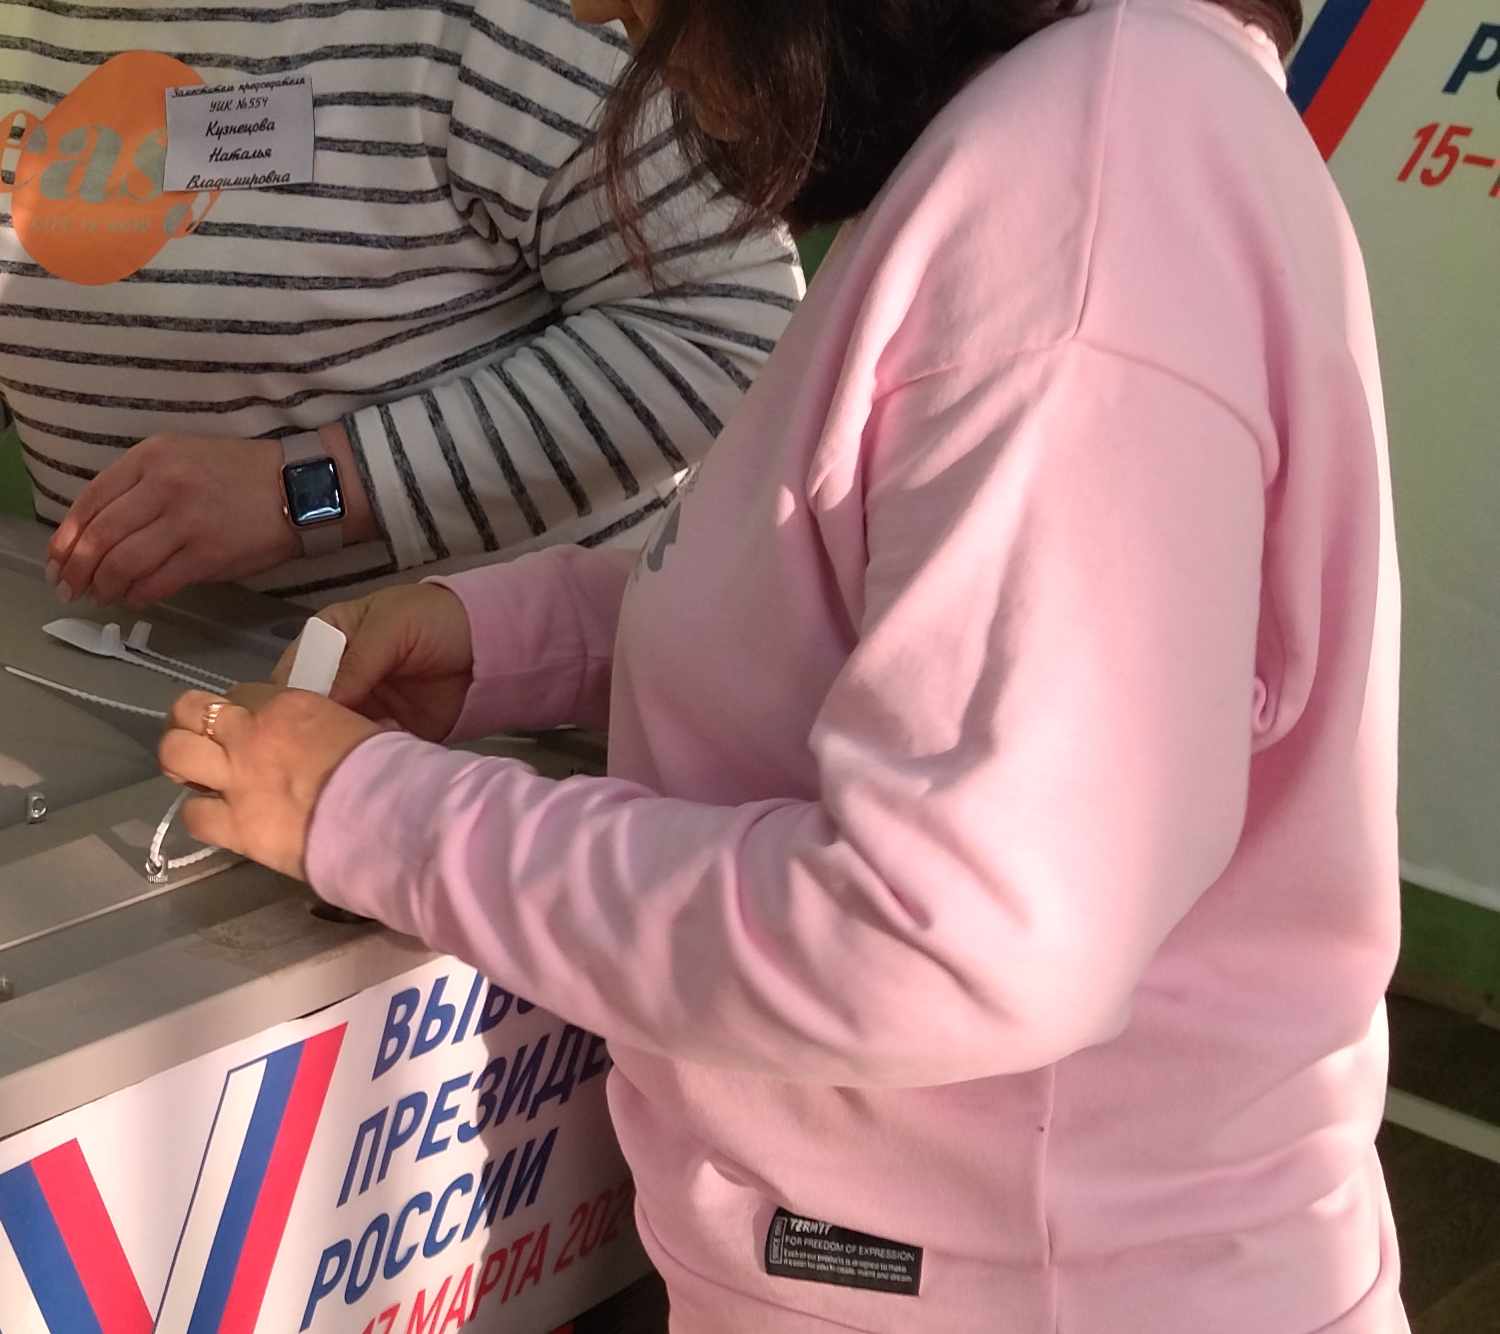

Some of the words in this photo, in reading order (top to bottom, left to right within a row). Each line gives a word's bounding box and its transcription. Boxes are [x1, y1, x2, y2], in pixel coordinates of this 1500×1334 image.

[205, 118, 276, 140] Кузнецова
[208, 147, 273, 163] Наталья
[186, 170, 291, 190] Владимировна
[372, 971, 536, 1081] ВЫБ
[336, 1023, 615, 1208] ПРЕЗИДЕ
[298, 1127, 558, 1334] РОССИИ
[553, 1178, 637, 1275] 202
[785, 1234, 803, 1246] FOR
[803, 1237, 844, 1252] FREEDOM
[845, 1243, 857, 1255] OF
[858, 1244, 915, 1262] EXPRESSION
